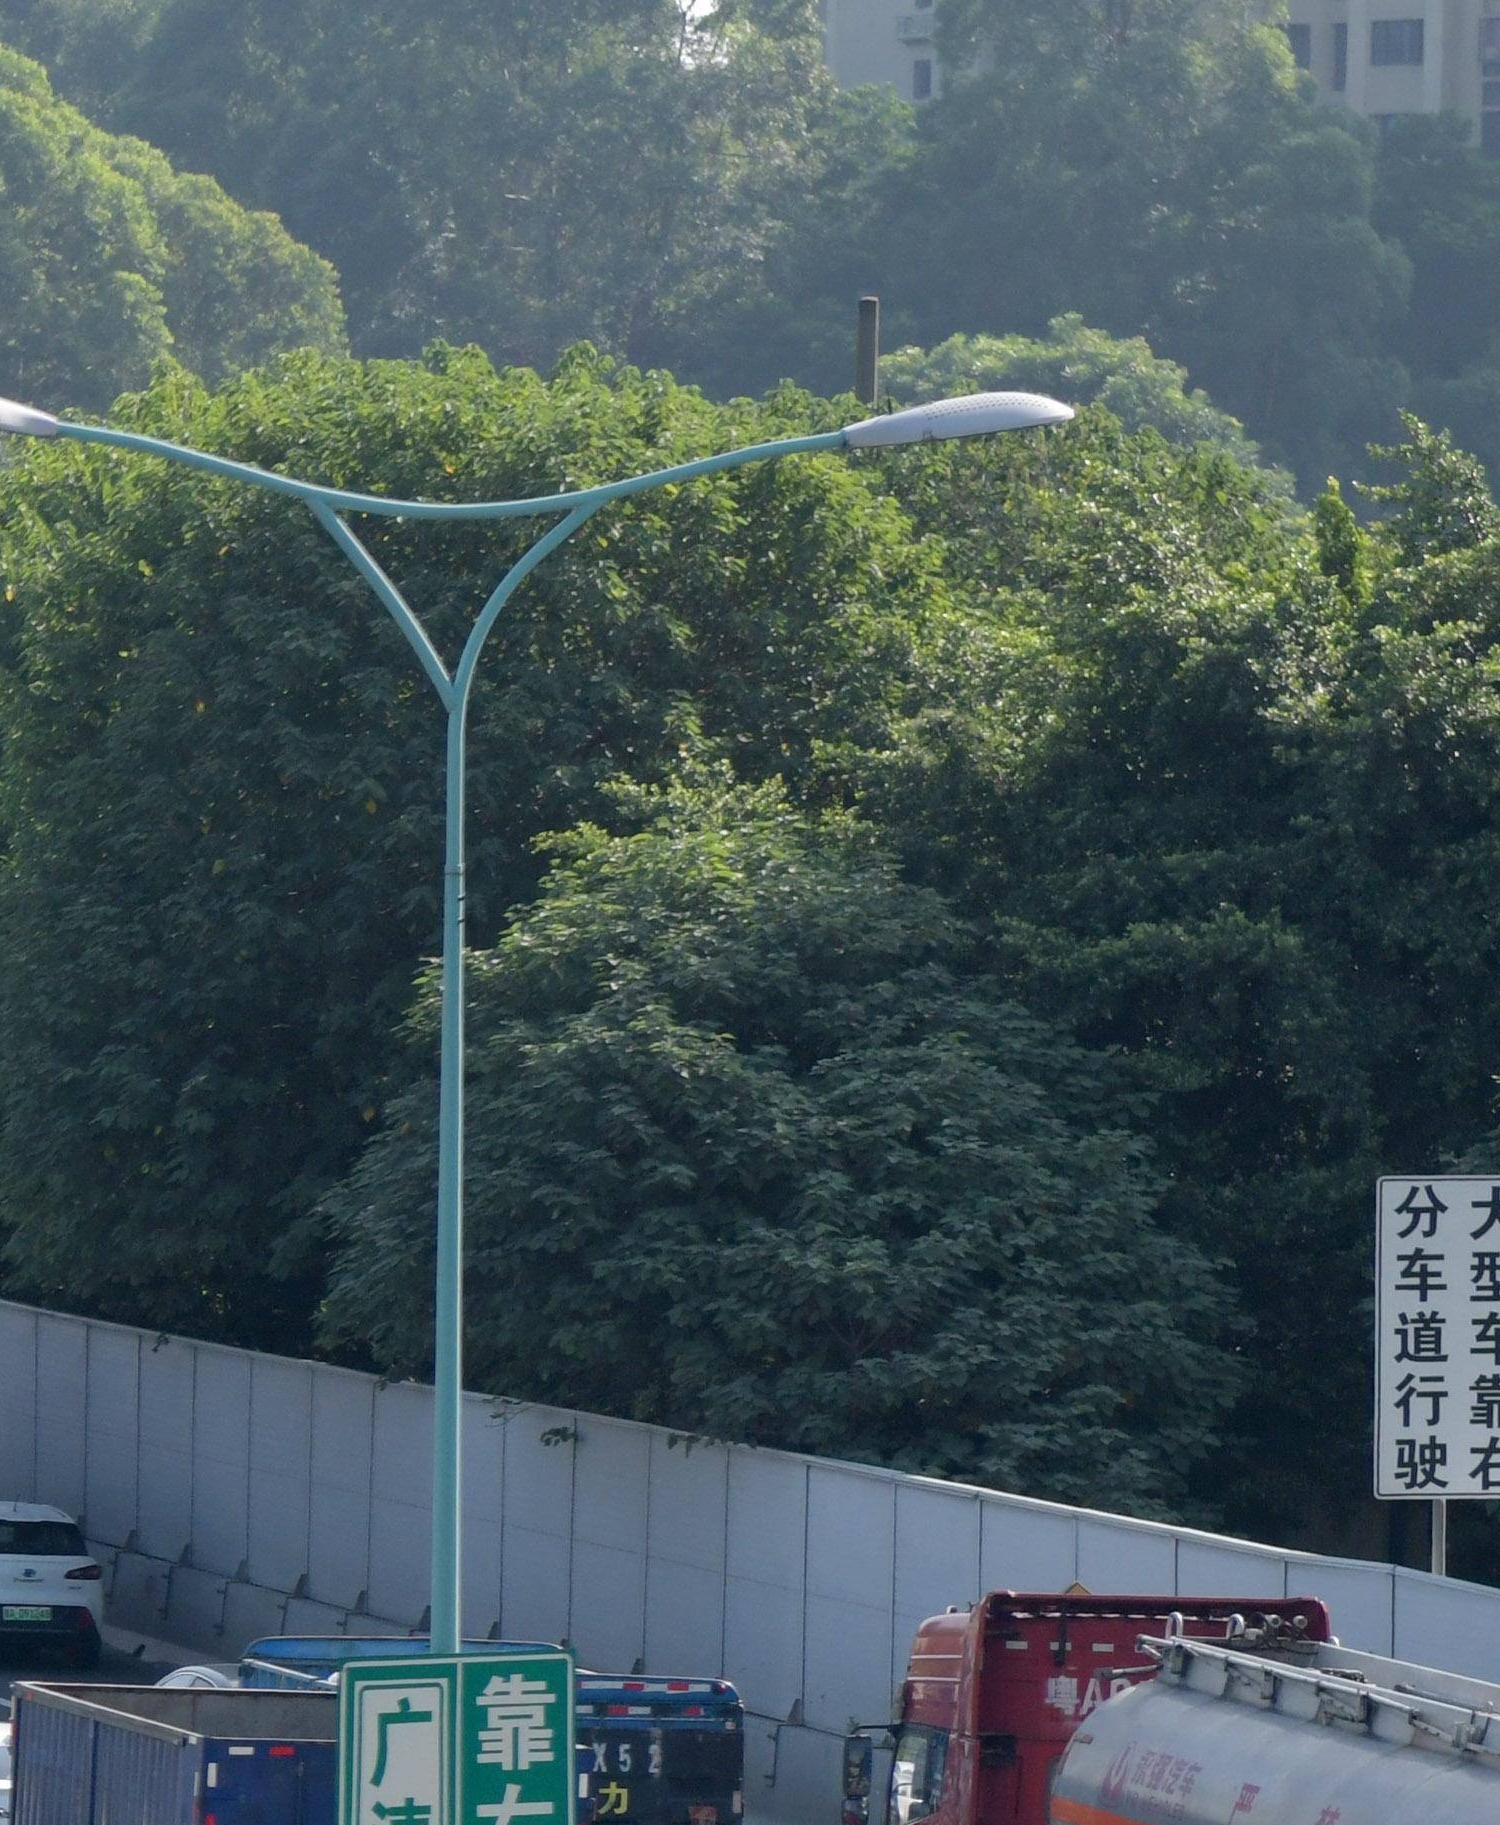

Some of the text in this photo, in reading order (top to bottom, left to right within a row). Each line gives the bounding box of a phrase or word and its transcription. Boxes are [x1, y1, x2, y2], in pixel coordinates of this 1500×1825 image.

[1394, 1184, 1449, 1490] 分车道行驶
[597, 1781, 629, 1816] 力
